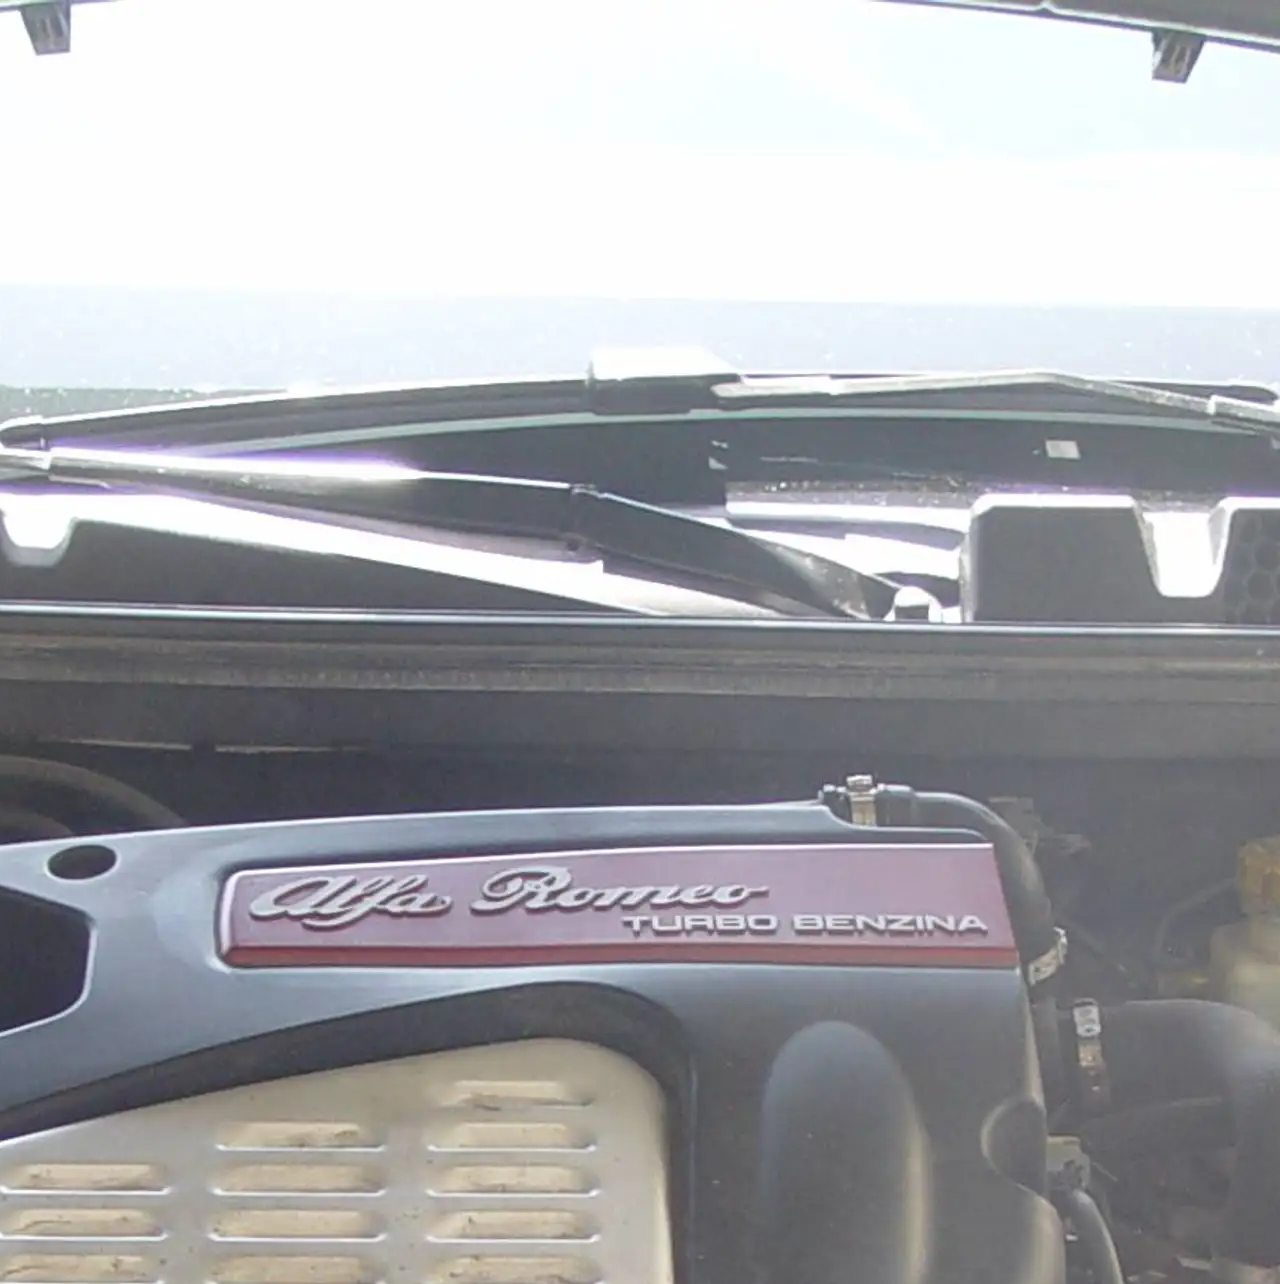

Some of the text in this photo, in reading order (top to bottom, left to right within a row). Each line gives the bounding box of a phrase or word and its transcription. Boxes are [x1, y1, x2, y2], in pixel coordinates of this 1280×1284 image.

[249, 866, 769, 930] Alfa Romeo
[622, 914, 989, 936] TURBO BENZINA
